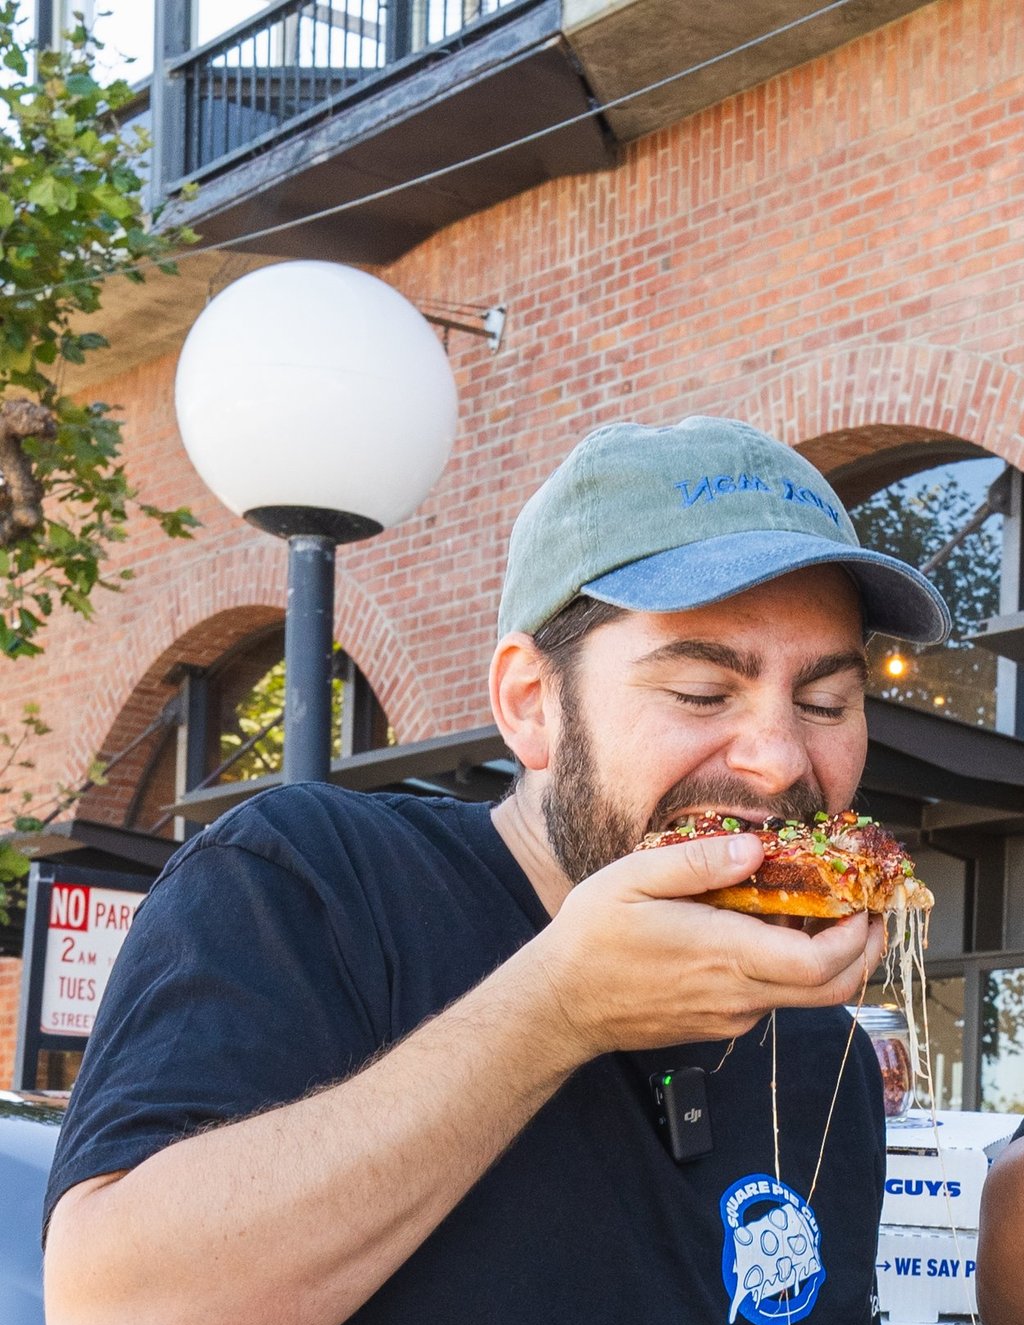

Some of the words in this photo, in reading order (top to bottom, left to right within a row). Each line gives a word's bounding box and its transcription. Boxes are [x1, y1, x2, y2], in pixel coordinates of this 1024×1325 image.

[50, 886, 86, 927] NO
[95, 901, 136, 930] PAR
[59, 975, 97, 1001] TUES
[884, 1178, 961, 1198] GUYS
[726, 1181, 771, 1228] SQUARE
[771, 1182, 800, 1208] PIE
[895, 1257, 922, 1276] WE
[927, 1259, 960, 1278] SAY
